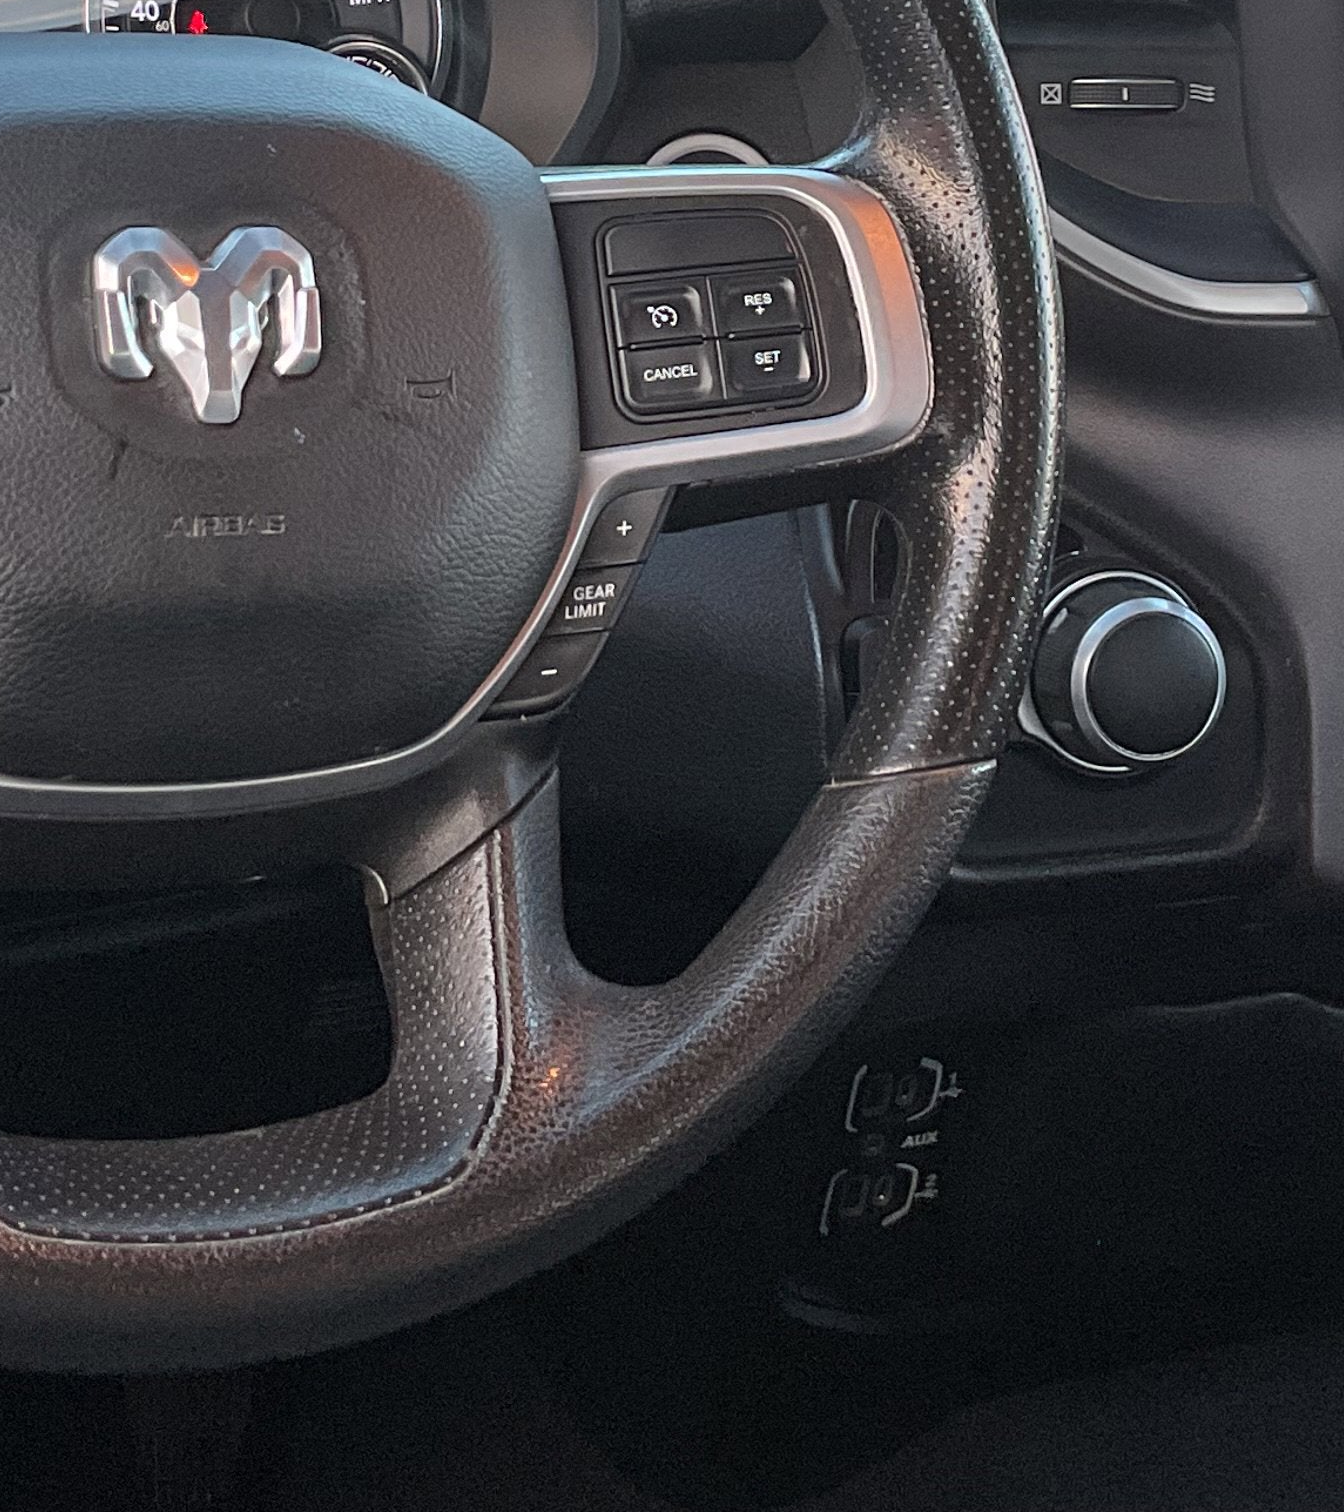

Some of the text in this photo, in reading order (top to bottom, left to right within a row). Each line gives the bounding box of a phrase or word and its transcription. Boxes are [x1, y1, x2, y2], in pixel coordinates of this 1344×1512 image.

[131, 0, 161, 22] 40
[155, 21, 170, 32] 60
[743, 292, 773, 306] RES
[754, 349, 781, 366] SET
[643, 363, 698, 383] CANCEL
[572, 583, 616, 601] GEAR
[564, 601, 607, 620] LIMIT
[900, 1130, 938, 1149] AUX
